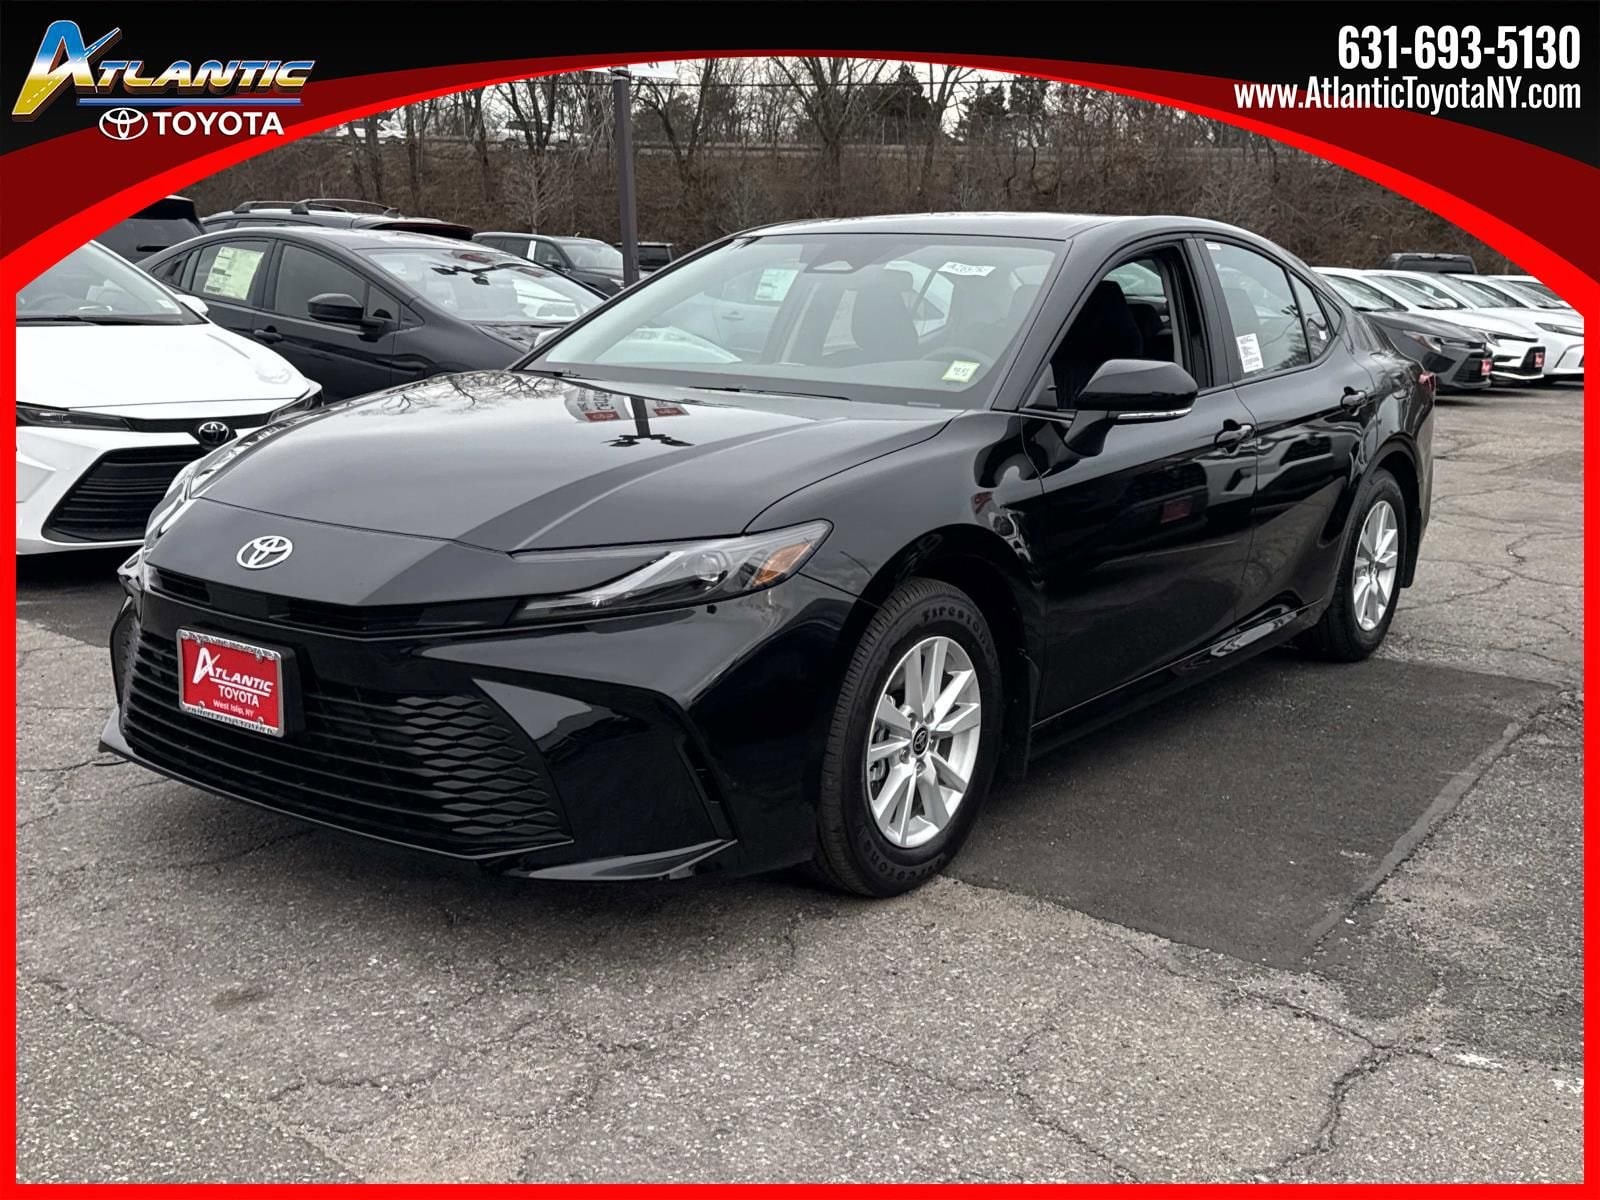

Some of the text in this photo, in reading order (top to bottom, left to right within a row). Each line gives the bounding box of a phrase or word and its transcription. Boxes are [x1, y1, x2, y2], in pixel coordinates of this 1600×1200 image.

[218, 685, 259, 708] TOYOTA
[212, 699, 229, 711] West
[245, 708, 255, 717] NY
